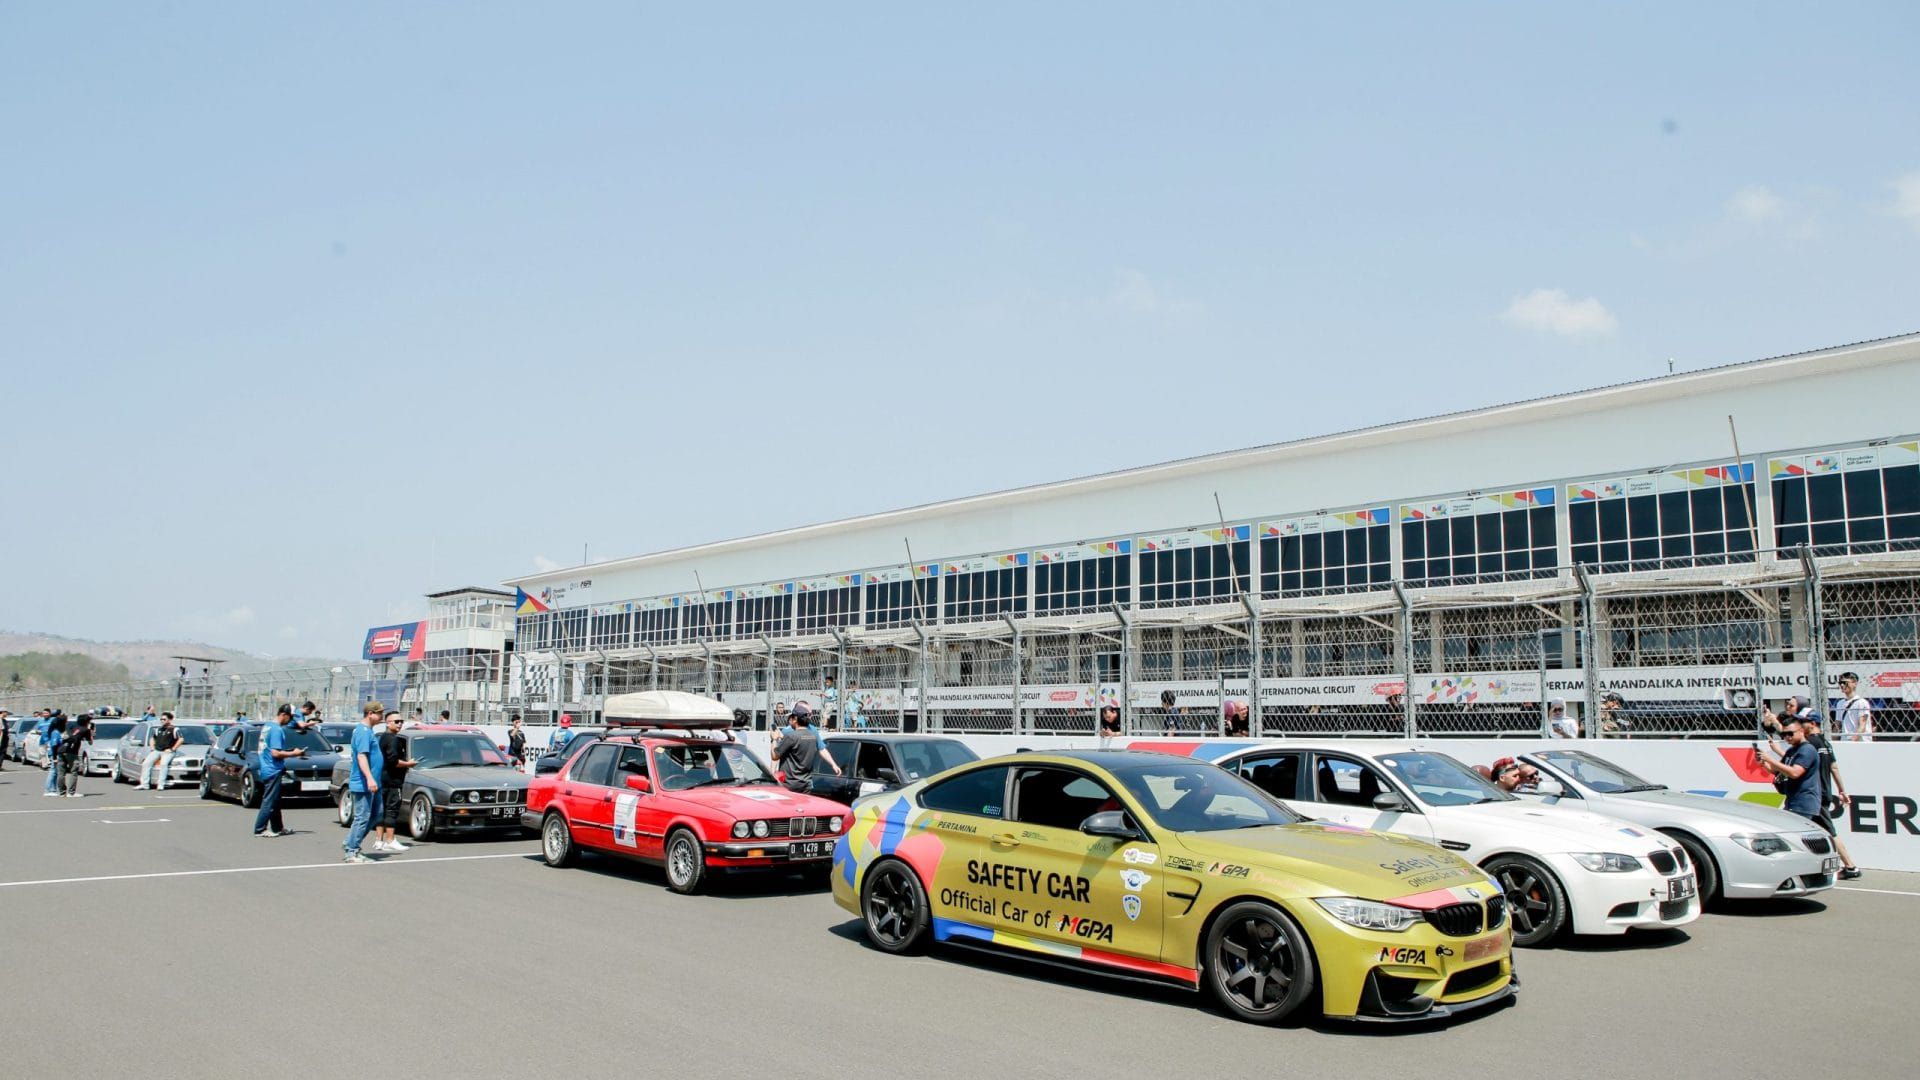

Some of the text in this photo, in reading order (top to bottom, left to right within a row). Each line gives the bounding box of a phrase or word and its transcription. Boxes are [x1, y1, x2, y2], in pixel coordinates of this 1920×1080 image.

[1546, 680, 1606, 690] ERTAMA
[1610, 678, 1683, 689] MANDALIKA
[1020, 692, 1040, 700] IRCUIT
[1206, 688, 1248, 697] MADALIK
[1323, 685, 1356, 694] CIRCUIT
[937, 821, 977, 833] PERTAMINA
[803, 842, 818, 853] 1478
[1168, 855, 1206, 869] TORQUE
[967, 859, 1091, 904] SAFETY CAR
[940, 887, 997, 917] Official
[1002, 901, 1029, 924] Car
[1033, 910, 1052, 929] of
